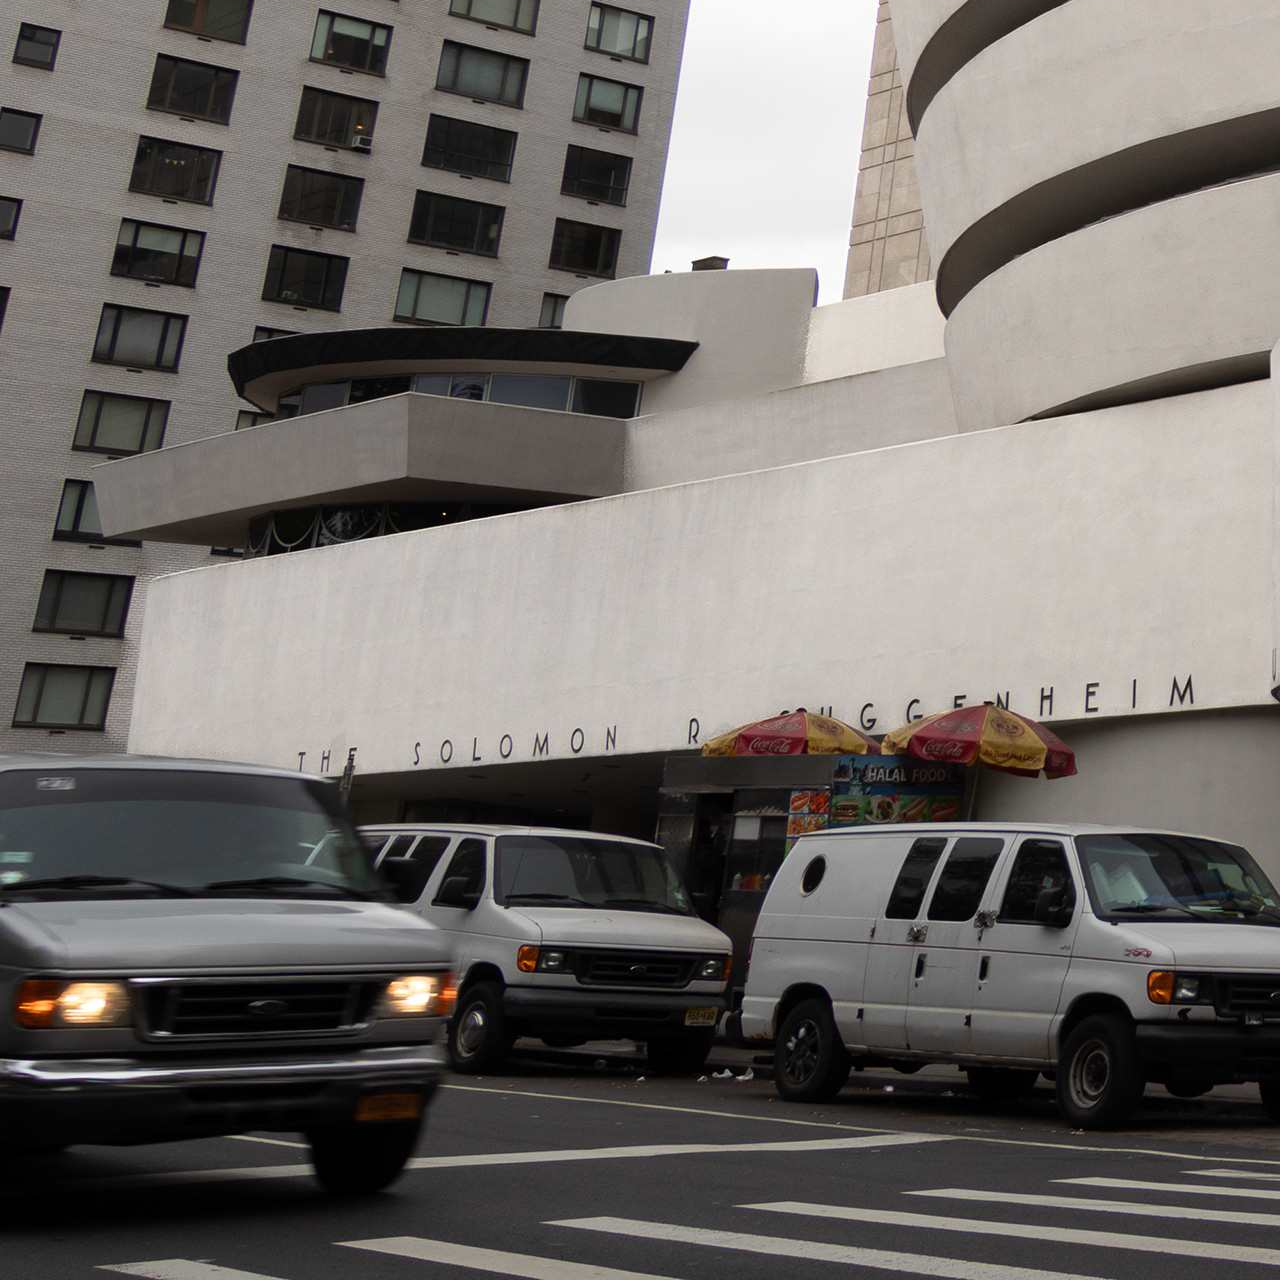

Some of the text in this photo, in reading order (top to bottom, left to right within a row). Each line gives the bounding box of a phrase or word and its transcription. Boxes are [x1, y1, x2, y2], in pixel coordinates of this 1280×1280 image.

[298, 747, 358, 773] THE
[413, 725, 618, 766] SOLOMON
[780, 674, 1195, 731] GGNHEIM
[1023, 753, 1042, 763] Dogs
[868, 768, 946, 783] HALAL FOOD
